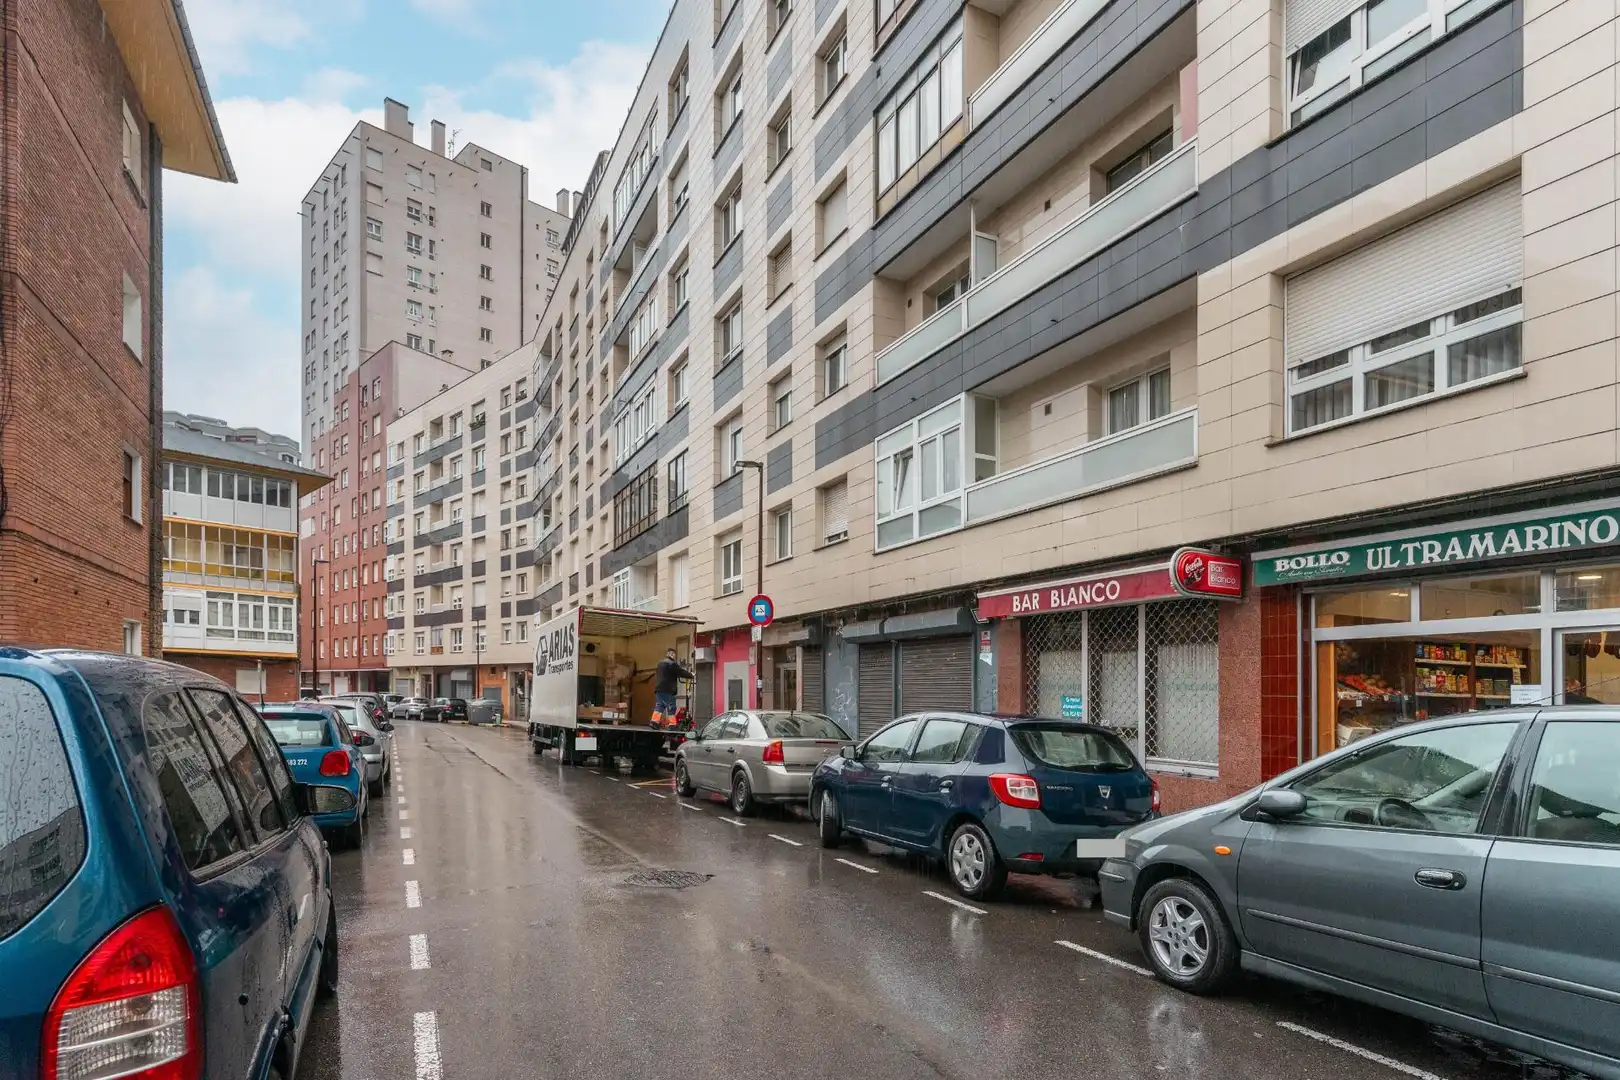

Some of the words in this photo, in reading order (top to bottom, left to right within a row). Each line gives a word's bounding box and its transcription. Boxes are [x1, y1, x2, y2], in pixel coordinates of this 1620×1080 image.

[1210, 563, 1223, 573] Bar
[1274, 551, 1350, 572] BOLLO
[1210, 573, 1236, 585] Blanco
[1012, 592, 1040, 612] BAR
[1050, 580, 1121, 608] BLANCO
[548, 622, 575, 663] ARIAS
[548, 660, 574, 675] Transportes
